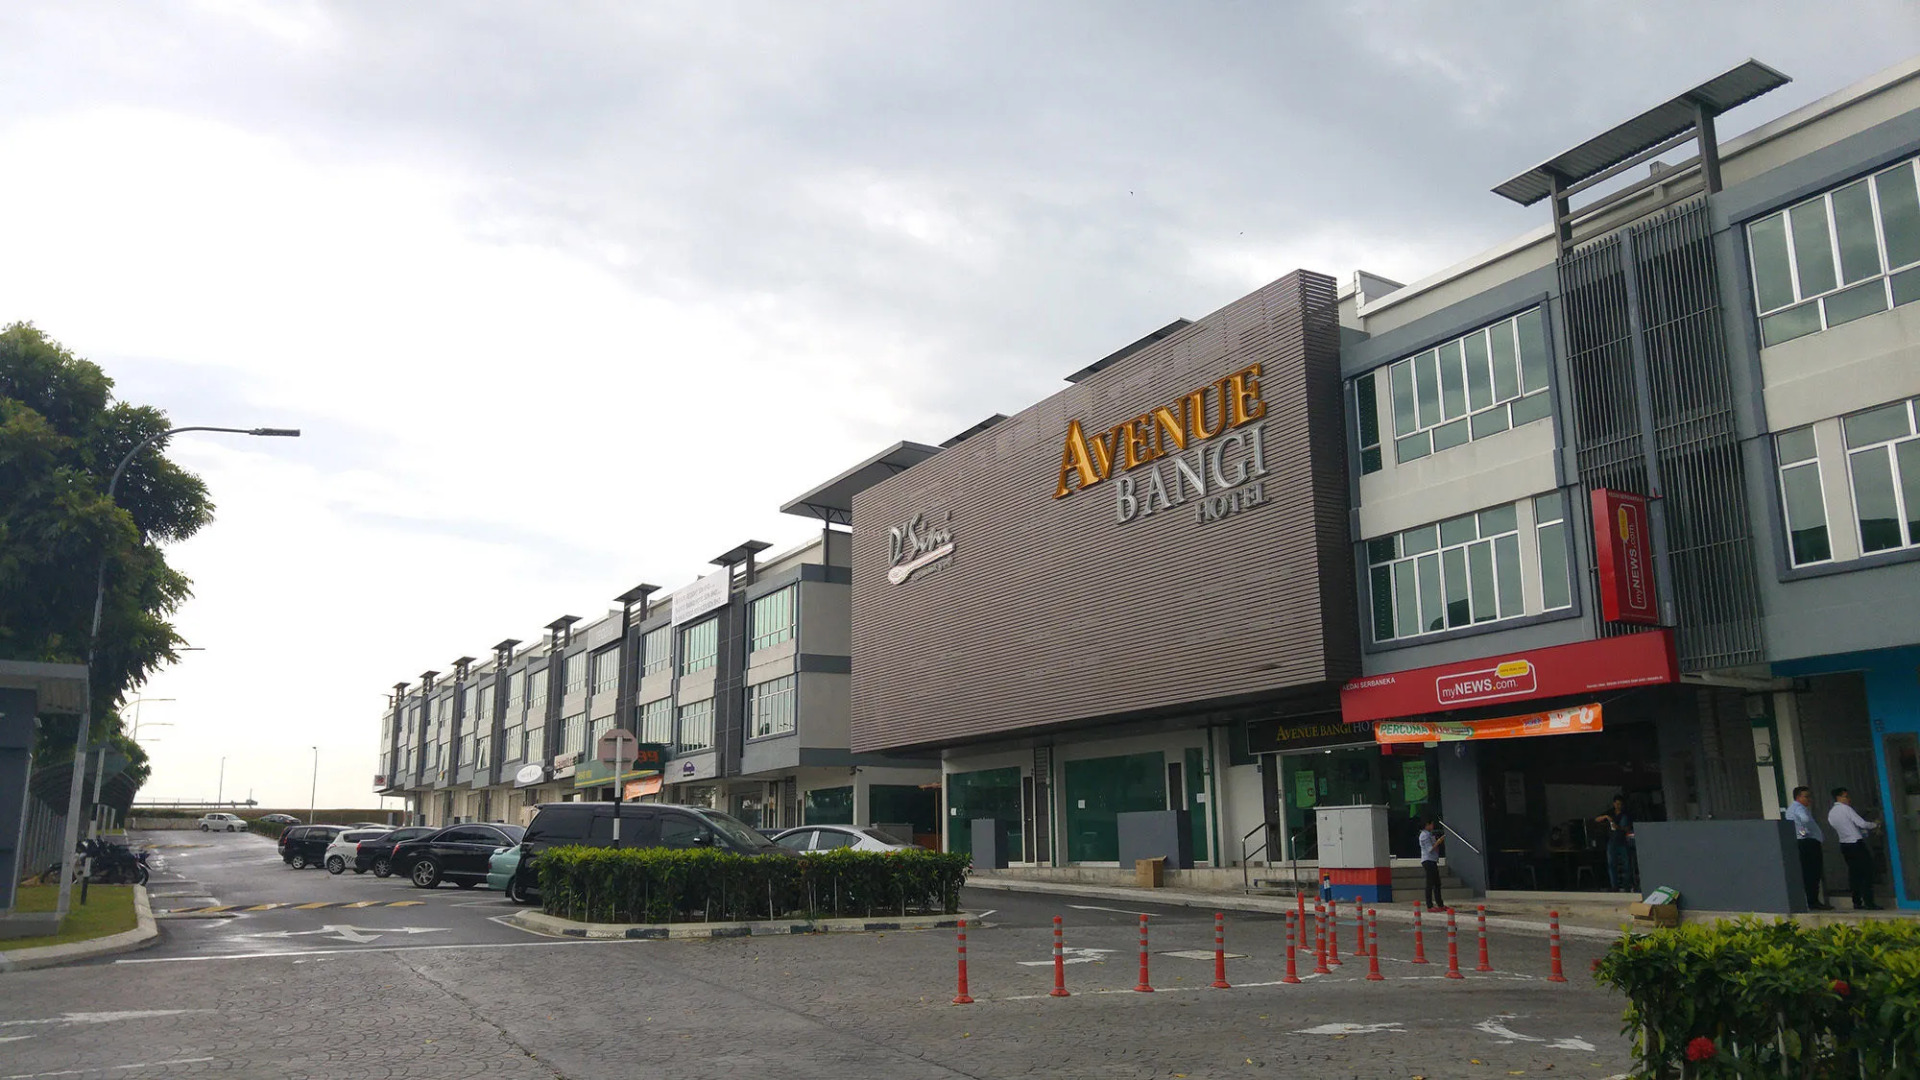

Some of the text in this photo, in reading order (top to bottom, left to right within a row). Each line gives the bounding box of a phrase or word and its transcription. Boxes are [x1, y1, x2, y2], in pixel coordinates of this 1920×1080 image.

[1051, 362, 1267, 500] AVENUE
[1113, 422, 1270, 525] BANGI
[1194, 483, 1267, 524] HOTEL
[1342, 676, 1396, 691] KEDAI SERBANEKA
[1276, 722, 1320, 741] AVENUE
[1320, 722, 1352, 737] BANGI
[1378, 723, 1430, 737] PERCUMA
